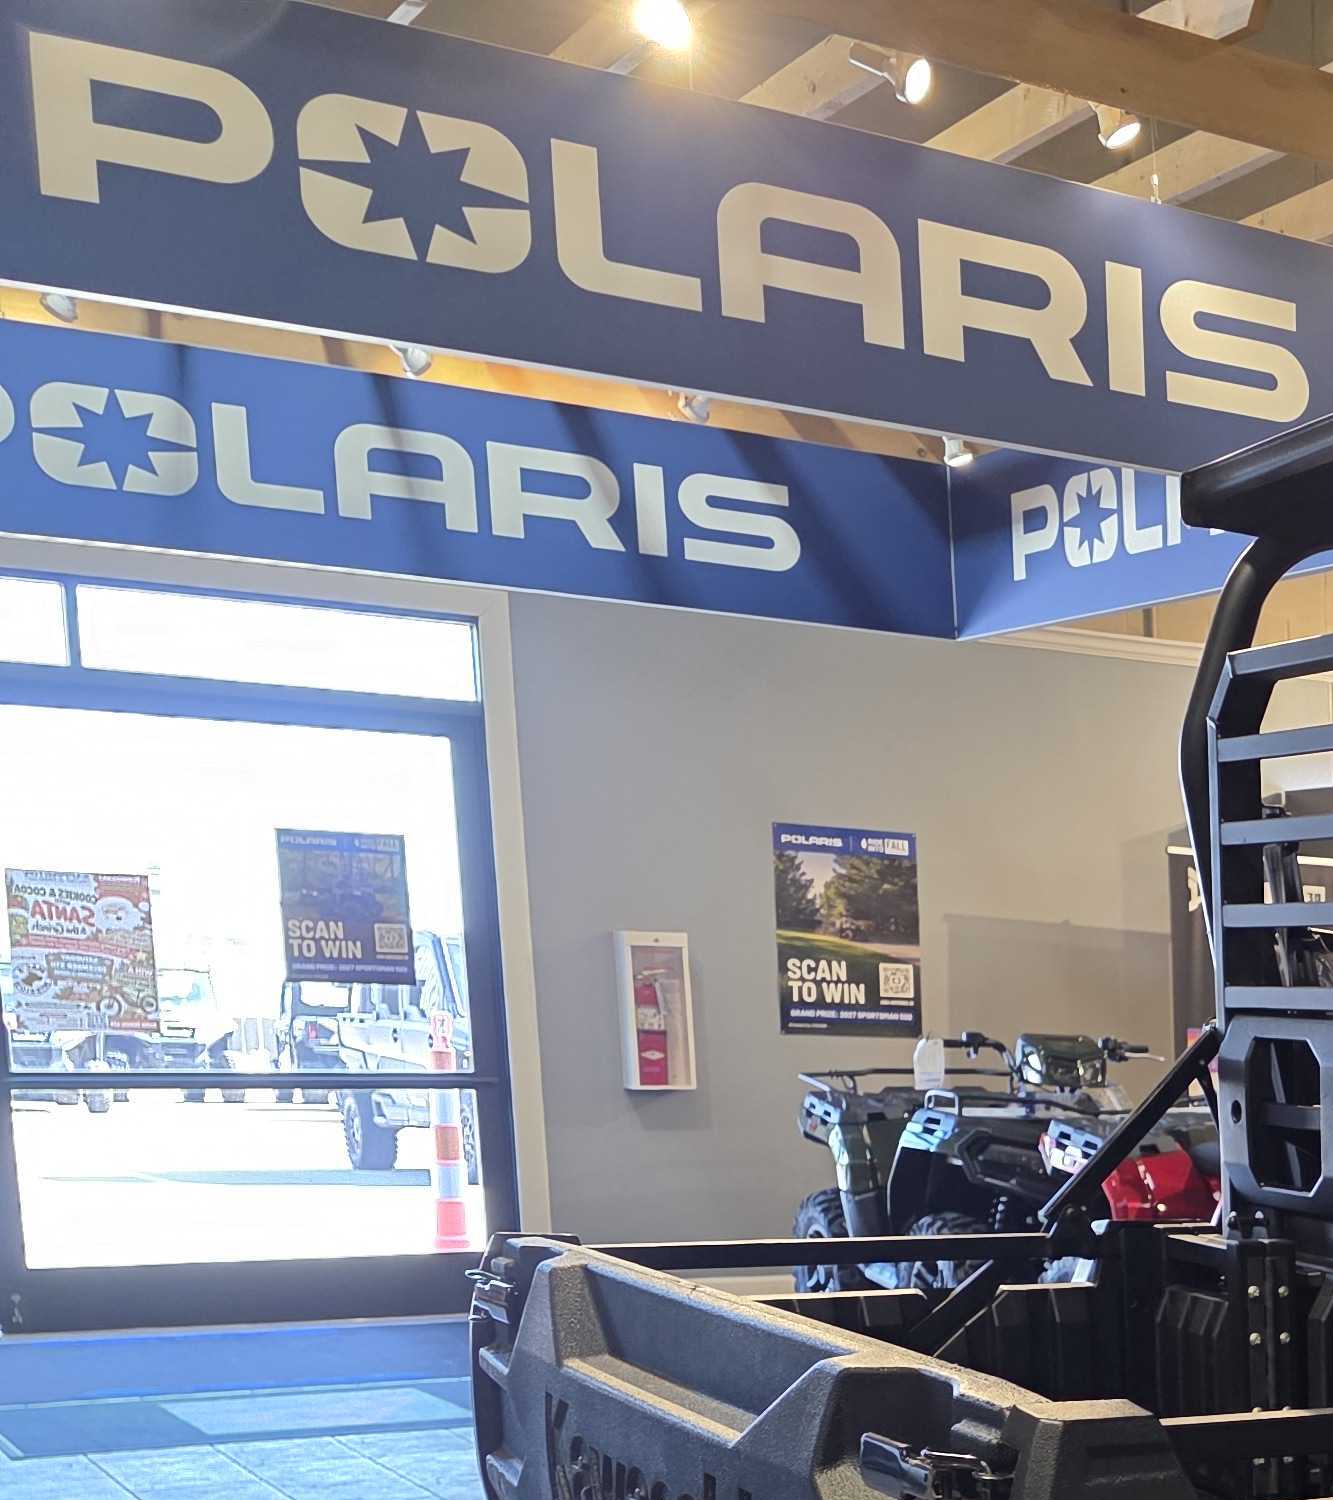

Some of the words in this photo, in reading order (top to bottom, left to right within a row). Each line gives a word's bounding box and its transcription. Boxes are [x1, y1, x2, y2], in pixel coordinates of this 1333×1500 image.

[27, 31, 1310, 423] POLARIS
[0, 381, 802, 572] OLARIS
[781, 834, 843, 847] POLARIS
[288, 919, 344, 940] SCAN
[289, 938, 317, 958] TO
[320, 940, 363, 959] WIN
[787, 958, 848, 981] SCAN
[788, 979, 817, 1002] TO
[822, 981, 866, 1005] WIN
